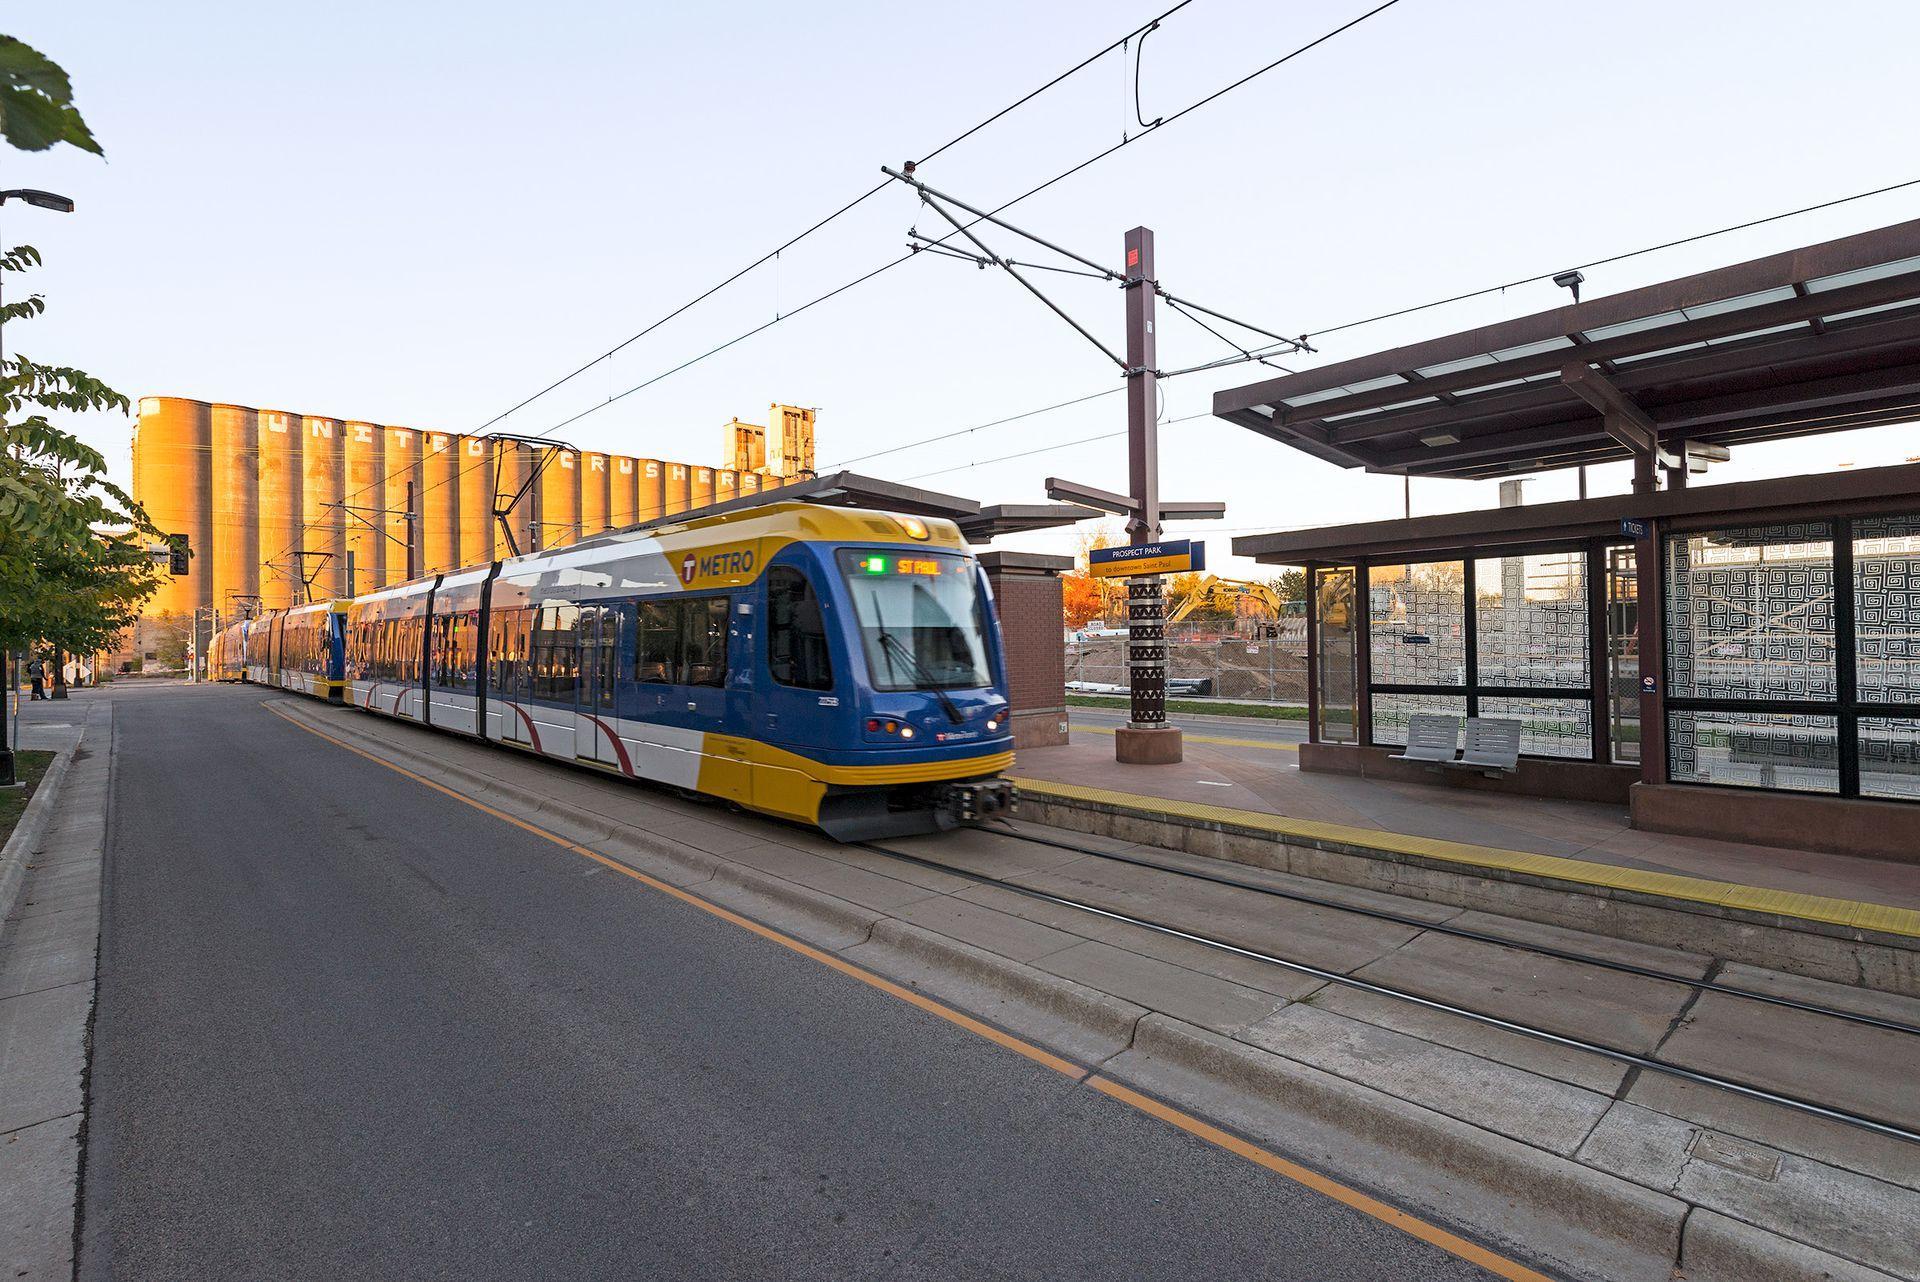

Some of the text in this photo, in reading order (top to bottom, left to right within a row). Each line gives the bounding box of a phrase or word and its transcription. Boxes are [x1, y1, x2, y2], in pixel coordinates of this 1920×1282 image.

[268, 414, 757, 489] UNITED CRUSHERS
[1112, 546, 1161, 558] PROSPECT PARK
[699, 550, 754, 577] METRO
[1113, 564, 1142, 572] downtown
[1143, 562, 1157, 570] Saint
[1159, 560, 1171, 568] Paul
